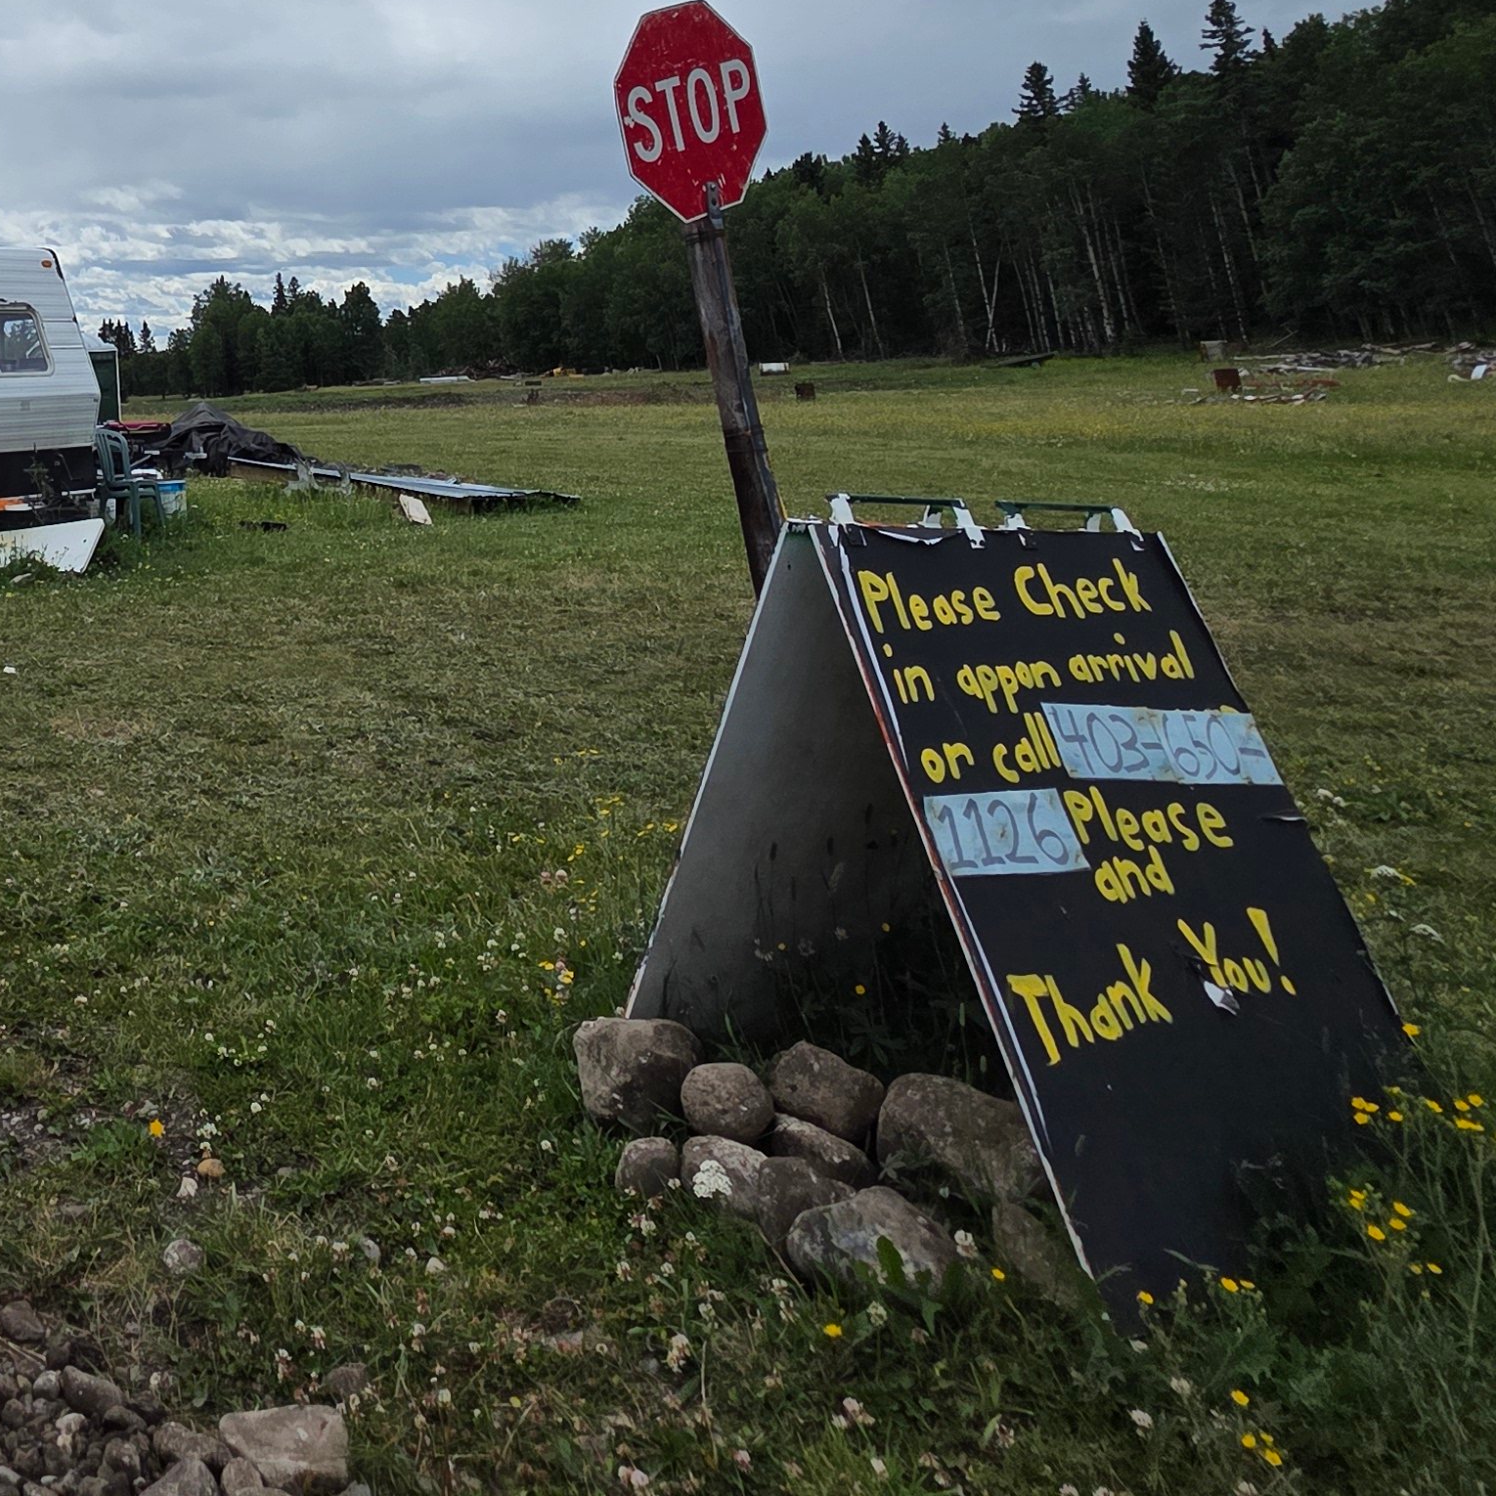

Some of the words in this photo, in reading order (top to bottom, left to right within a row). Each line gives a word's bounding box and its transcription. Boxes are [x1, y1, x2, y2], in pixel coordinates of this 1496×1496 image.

[624, 59, 750, 163] STOP
[857, 570, 1001, 634] Please
[1014, 557, 1152, 619] Check
[882, 643, 935, 704] in
[956, 660, 1062, 714] appon
[1068, 629, 1195, 683] arrival
[920, 742, 974, 784] or
[992, 711, 1061, 784] call
[937, 792, 1070, 868] 1126
[1063, 785, 1234, 852] Please
[1094, 844, 1175, 904] and
[1006, 943, 1173, 1066] Thank
[1177, 907, 1297, 996] You!
